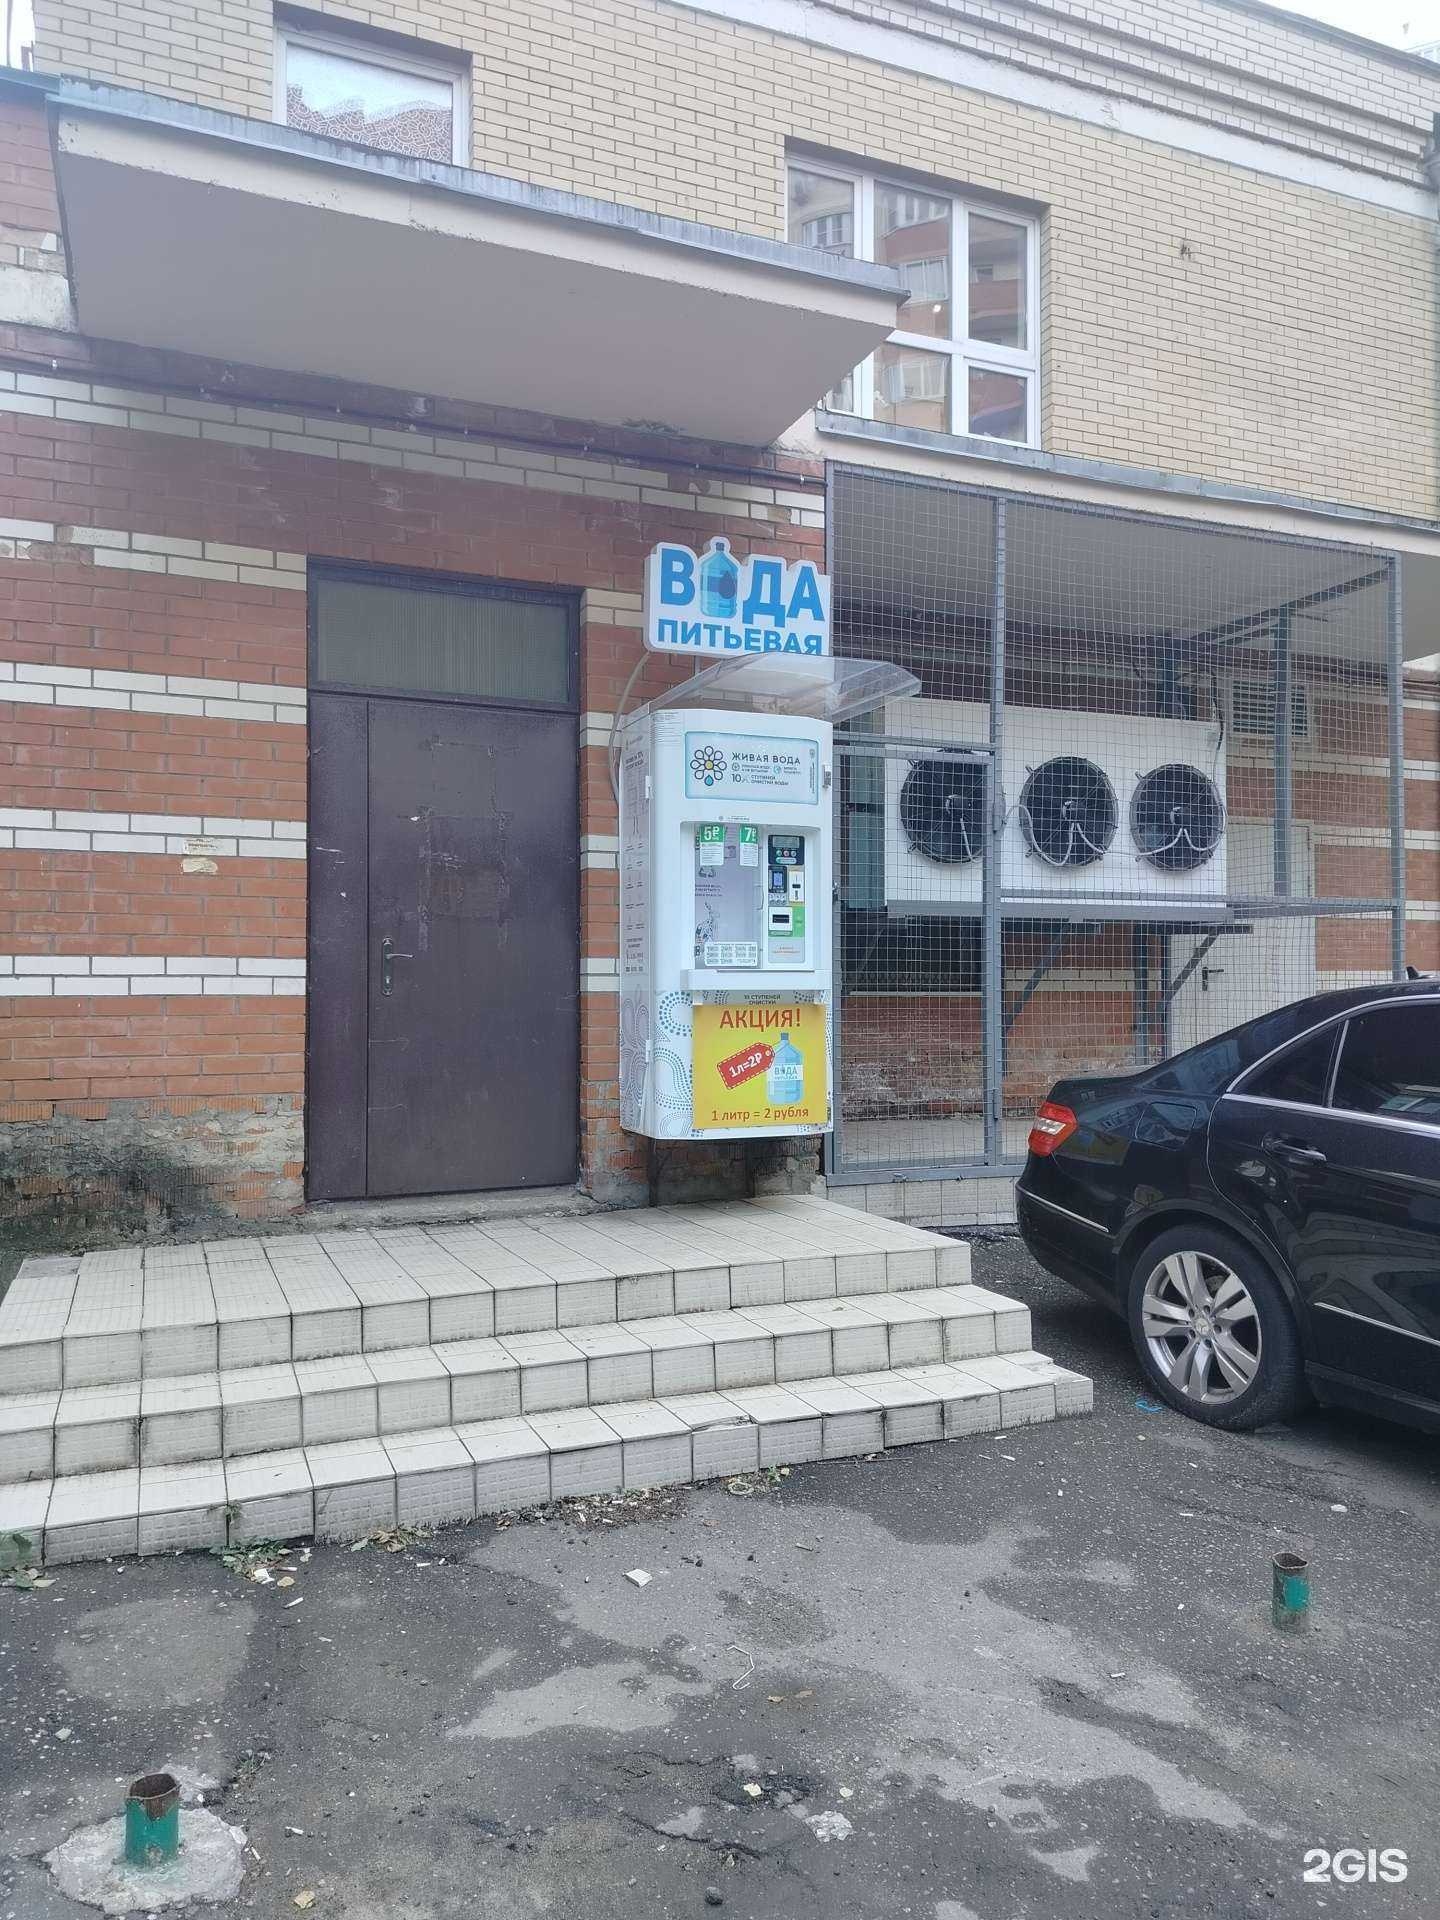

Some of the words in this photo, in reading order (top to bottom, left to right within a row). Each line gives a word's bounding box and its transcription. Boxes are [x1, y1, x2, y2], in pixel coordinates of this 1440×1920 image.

[657, 619, 822, 656] ПИТЬЕВАЯ
[731, 752, 769, 763] ЖИВАЯ
[772, 755, 801, 765] ВОДА
[719, 1008, 801, 1032] АКЦИЯ!
[712, 1110, 718, 1121] 1
[721, 1110, 750, 1122] литр
[764, 1108, 771, 1119] 2
[774, 1106, 809, 1121] рубля
